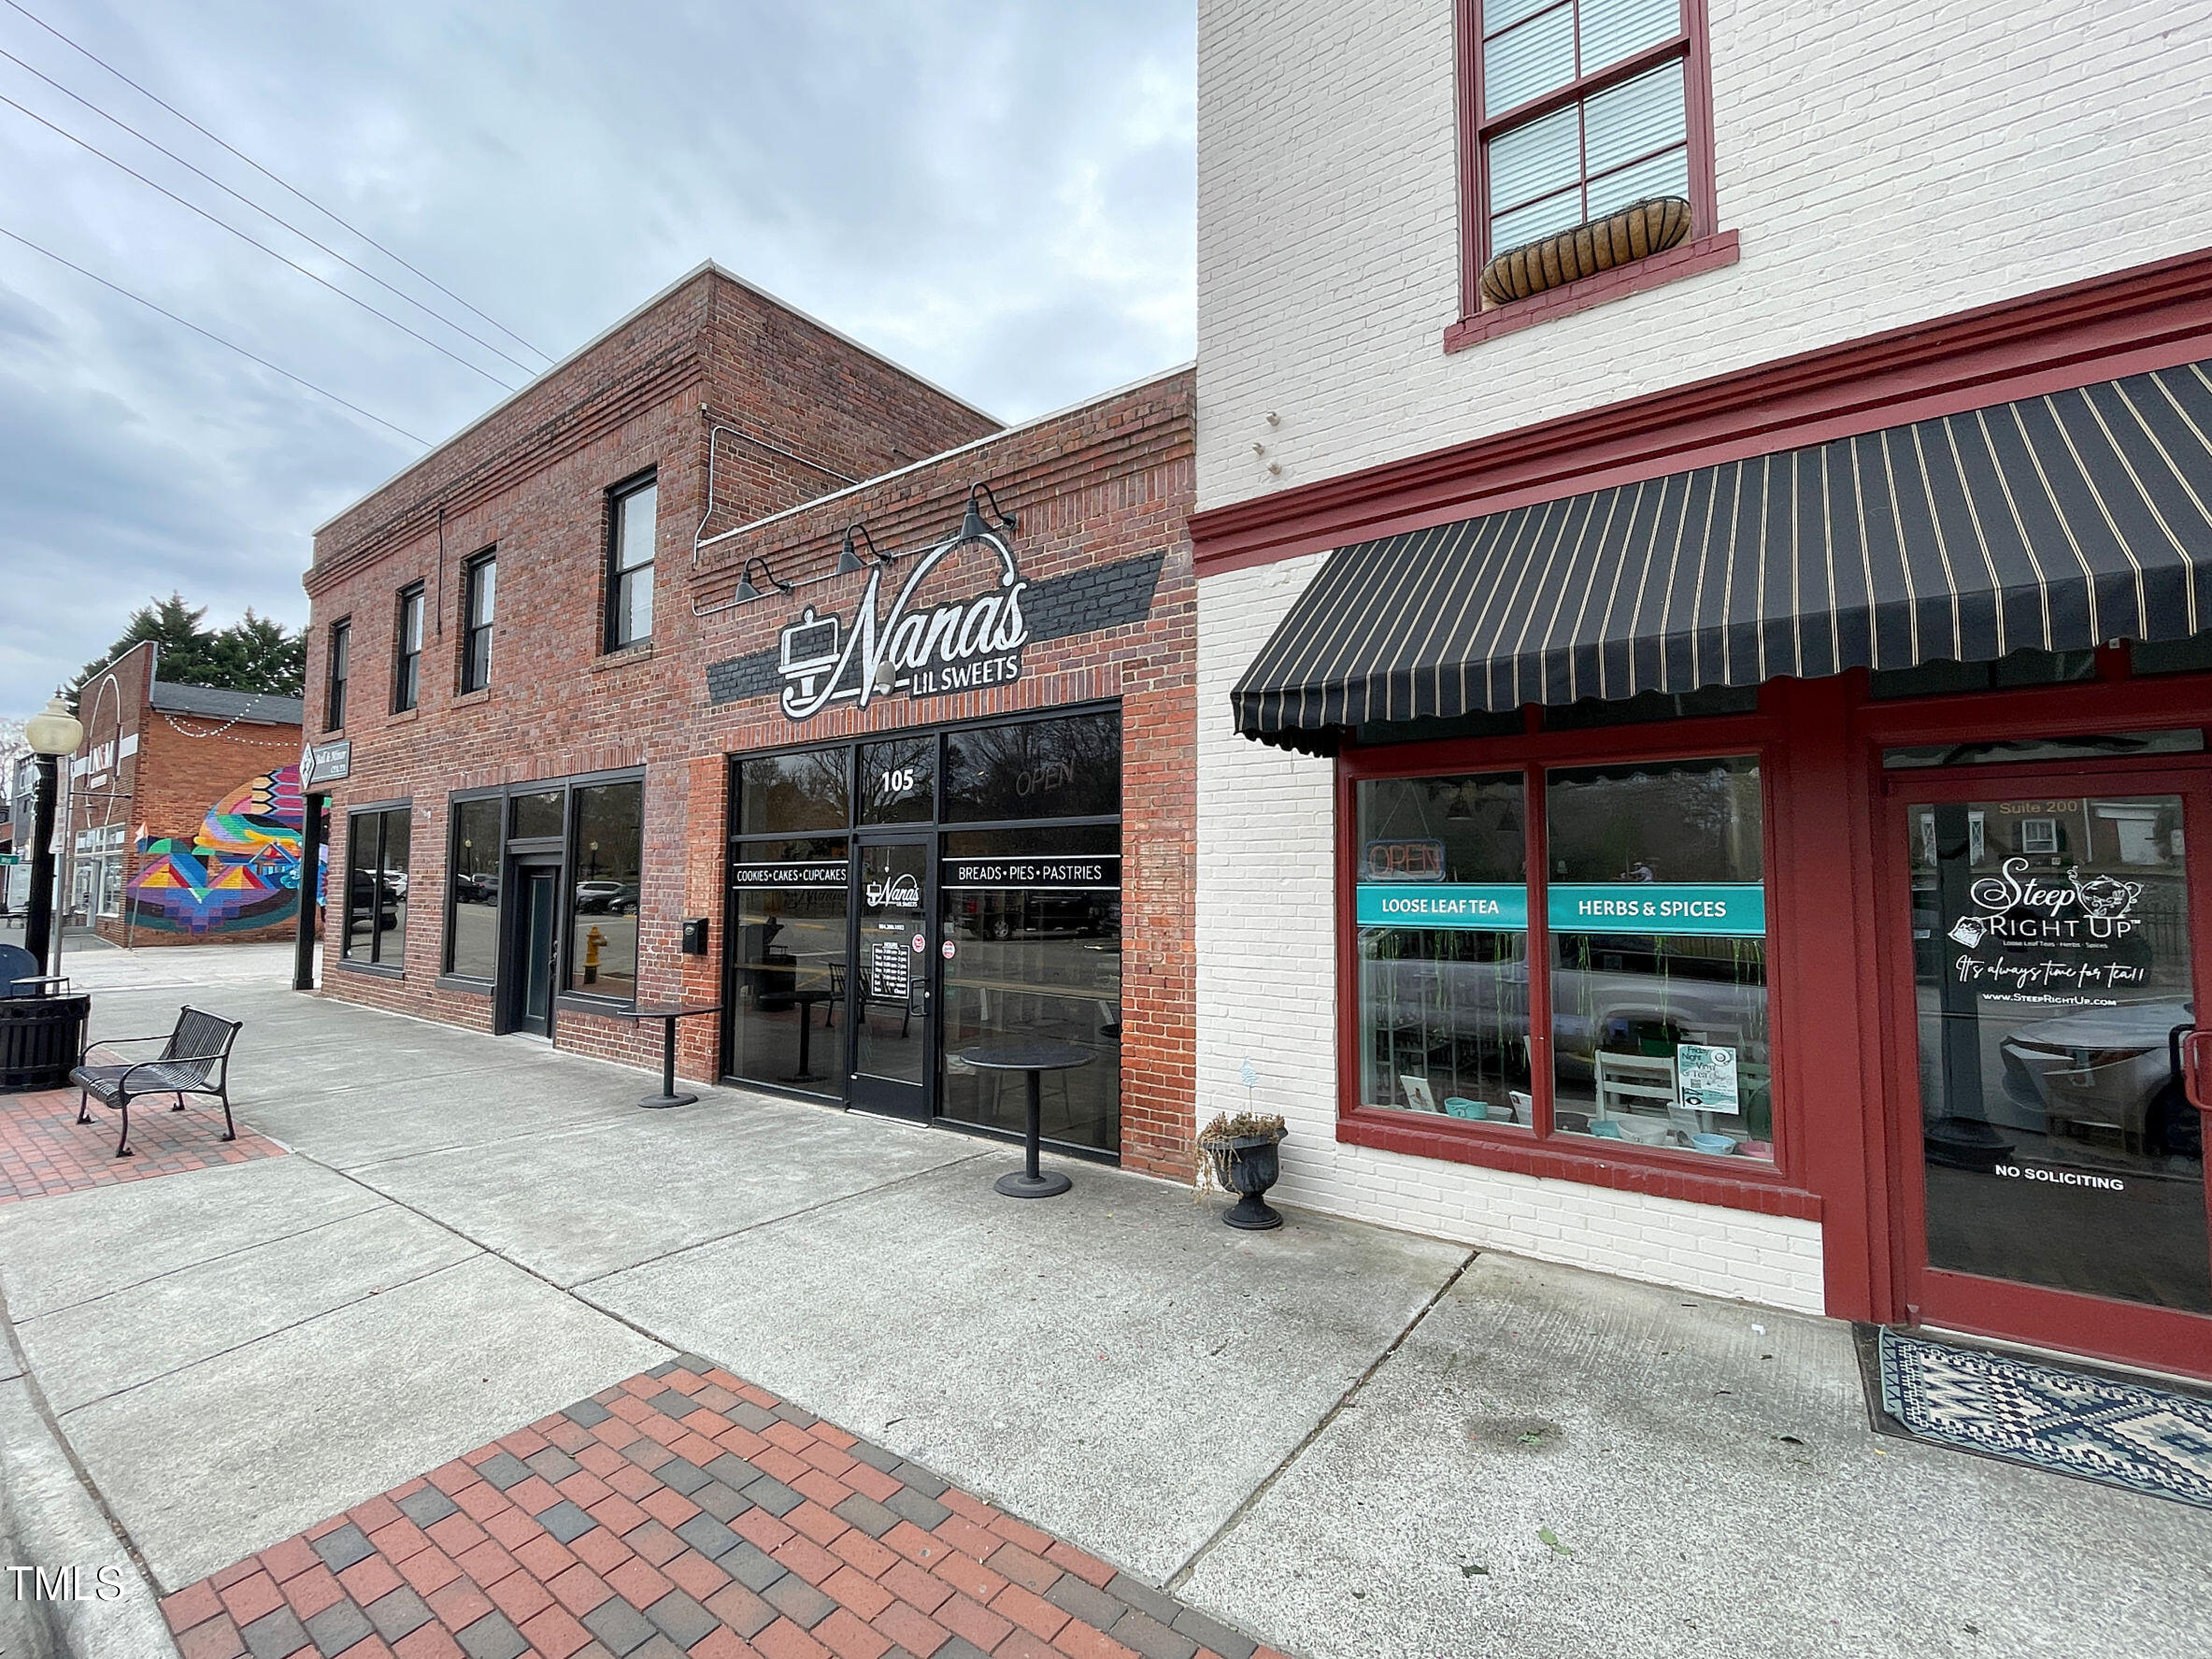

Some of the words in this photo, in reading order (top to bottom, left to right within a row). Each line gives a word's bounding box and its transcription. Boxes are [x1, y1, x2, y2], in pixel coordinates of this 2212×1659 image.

[912, 670, 937, 696] LIL
[941, 660, 1019, 692] SWEETS
[881, 768, 914, 793] 105
[1016, 758, 1075, 795] OPEN
[2000, 802, 2042, 815] Suite
[2047, 800, 2077, 813] 200
[959, 866, 1002, 880] BREADS
[1009, 865, 1035, 880] PIES
[1043, 865, 1102, 880] PASTRIES
[1370, 844, 1440, 877] OPEN
[736, 870, 769, 882] COOKIES
[773, 869, 799, 881] CAKES
[803, 868, 847, 881] CUPCAKES
[1971, 857, 2076, 917] Steep
[1382, 898, 1428, 913] LOOSE
[1431, 899, 1467, 913] LEAF
[1468, 899, 1500, 914] TEA
[1578, 900, 1639, 916] HERBS
[1643, 901, 1656, 916] &
[1660, 901, 1727, 918] SPICES
[1991, 916, 2079, 937] RIGHT
[1956, 954, 1985, 982] It's
[1988, 956, 2042, 989] always
[2039, 960, 2077, 986] time
[2078, 963, 2102, 988] for
[1995, 1164, 2020, 1179] NO
[2024, 1167, 2124, 1192] SOLICITING
